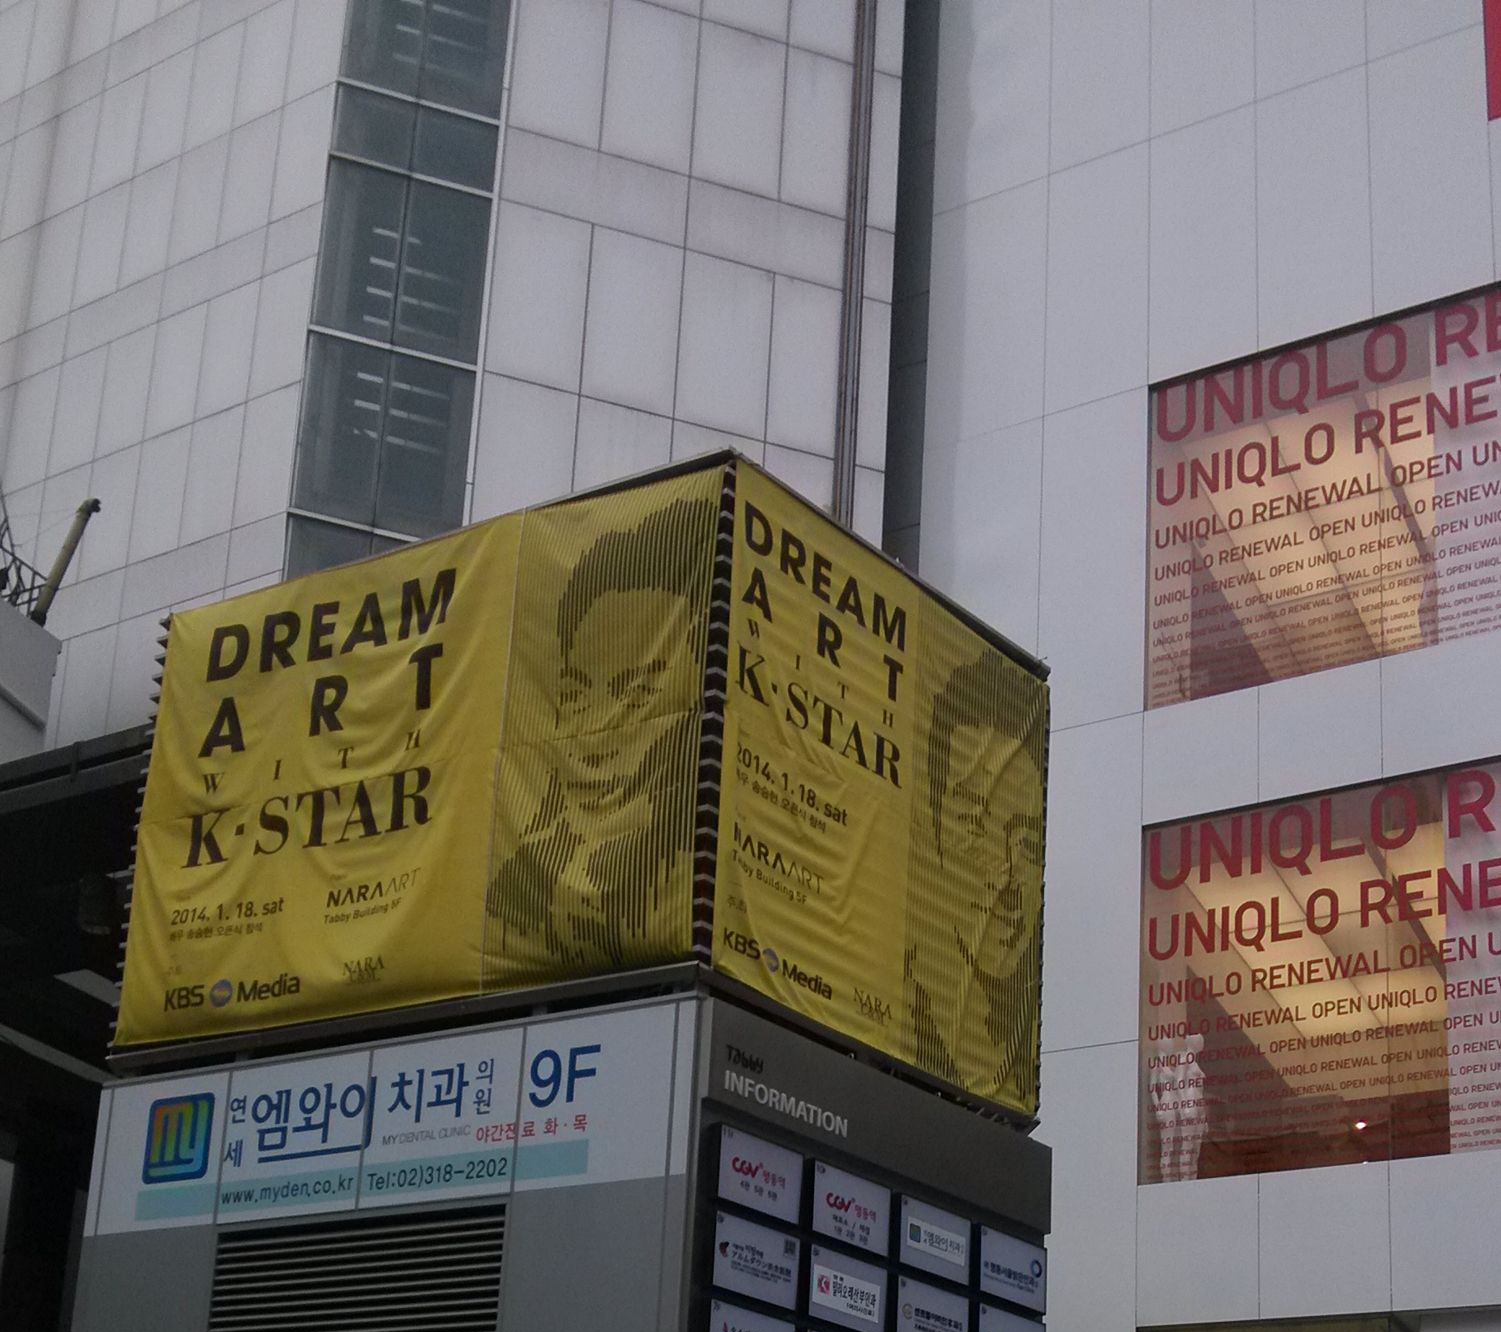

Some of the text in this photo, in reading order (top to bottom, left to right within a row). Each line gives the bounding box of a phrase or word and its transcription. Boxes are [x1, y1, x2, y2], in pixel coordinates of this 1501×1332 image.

[1157, 322, 1407, 442] UNIQLO
[1156, 374, 1501, 506] UNIQLO RENE
[1155, 450, 1462, 549] UNIQLO RENEWAL OPEN
[1154, 518, 1469, 606] UNIQLO RENEWAL OPEN UNIQLO RENEWAL OPEN
[1155, 554, 1214, 581] UNIQLO
[1219, 531, 1304, 565] RENEWAL
[1309, 516, 1356, 541] OPEN
[1361, 499, 1426, 528] UNIQLO
[745, 501, 907, 652] DREAM
[1153, 613, 1190, 629] UNIQLO
[1192, 601, 1242, 620] RENEWAL
[1245, 592, 1272, 607] OPEN
[1276, 582, 1313, 599] UNIQLO
[1316, 568, 1369, 590] RENEWAL
[1373, 560, 1402, 576] OPEN
[1406, 550, 1446, 567] UNIQLO
[1288, 594, 1332, 614] RENEWAL
[1335, 590, 1359, 602] OPEN
[1362, 581, 1395, 596] UNIQLO
[1446, 563, 1472, 576] OPEN
[206, 568, 457, 683] DREAM
[823, 804, 848, 827] sat
[1149, 784, 1417, 891] UNIQLO
[262, 897, 284, 917] sat
[326, 867, 421, 908] NARAART
[1148, 888, 1339, 960] UNIQLO
[164, 973, 301, 1012] KBS Media
[723, 927, 833, 1000] KBS Media
[1149, 935, 1477, 1006] UNIQLO RENEWAL OPEN
[1148, 1013, 1483, 1069] UNIQLO RENEWAL OPEN UNIQLO RENEWAL OPEN
[1149, 1018, 1210, 1041] UNIQLO
[1216, 1005, 1306, 1033] RENEWAL
[1312, 996, 1361, 1019] OPEN
[1368, 986, 1437, 1011] UNIQLO
[1276, 1062, 1318, 1078] UNIQLO
[1321, 1056, 1378, 1072] RENEWAL
[1381, 1051, 1412, 1065] OPEN
[1417, 1044, 1460, 1060] UNIQLO
[1340, 1079, 1366, 1091] OPEN
[1407, 1068, 1456, 1081] RENEWAL
[1460, 1064, 1487, 1076] OPEN
[251, 1044, 602, 1153] 엠와이 치과 9F
[438, 1125, 471, 1140] CLINIC
[723, 1069, 848, 1138] INFORMATION
[221, 1173, 354, 1206] www.myden.co.kr
[731, 1156, 759, 1178] CGV
[826, 1192, 852, 1212] CGV
